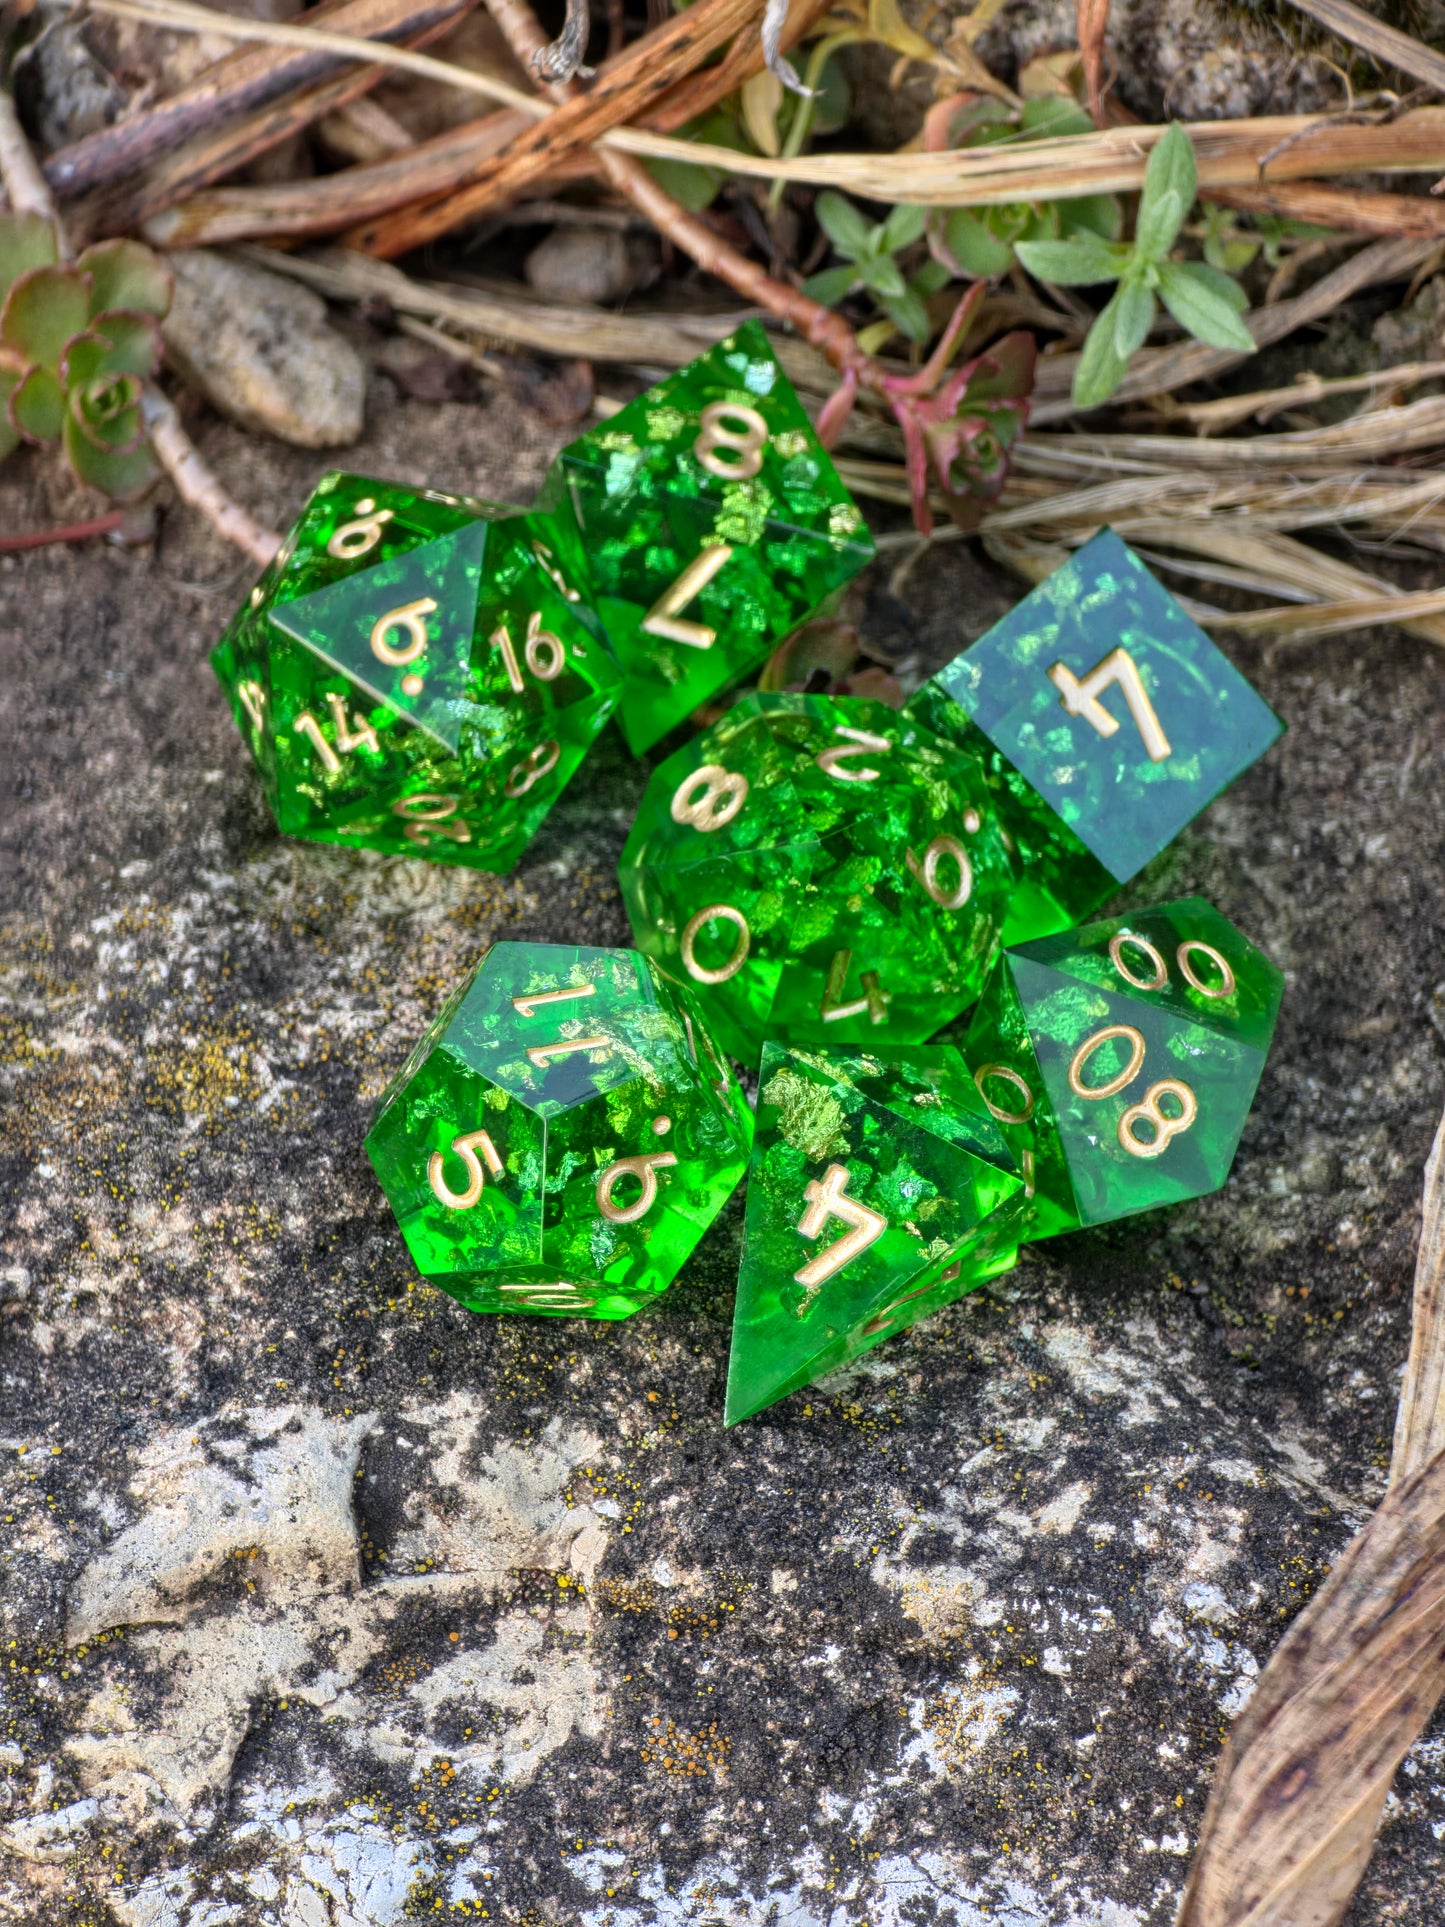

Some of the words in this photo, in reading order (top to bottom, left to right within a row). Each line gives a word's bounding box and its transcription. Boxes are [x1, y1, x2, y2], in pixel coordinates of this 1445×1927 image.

[694, 401, 768, 480] 8
[642, 543, 732, 649] 7
[489, 611, 564, 693] 16
[294, 692, 379, 771] 14
[1046, 645, 1171, 763] 4
[816, 725, 892, 781] 2
[671, 764, 748, 832] 8
[681, 904, 751, 985] 0
[1108, 934, 1235, 998] 00
[512, 984, 613, 1068] 11
[820, 949, 892, 1025] 4
[427, 1129, 505, 1210] 5
[793, 1163, 887, 1289] 4
